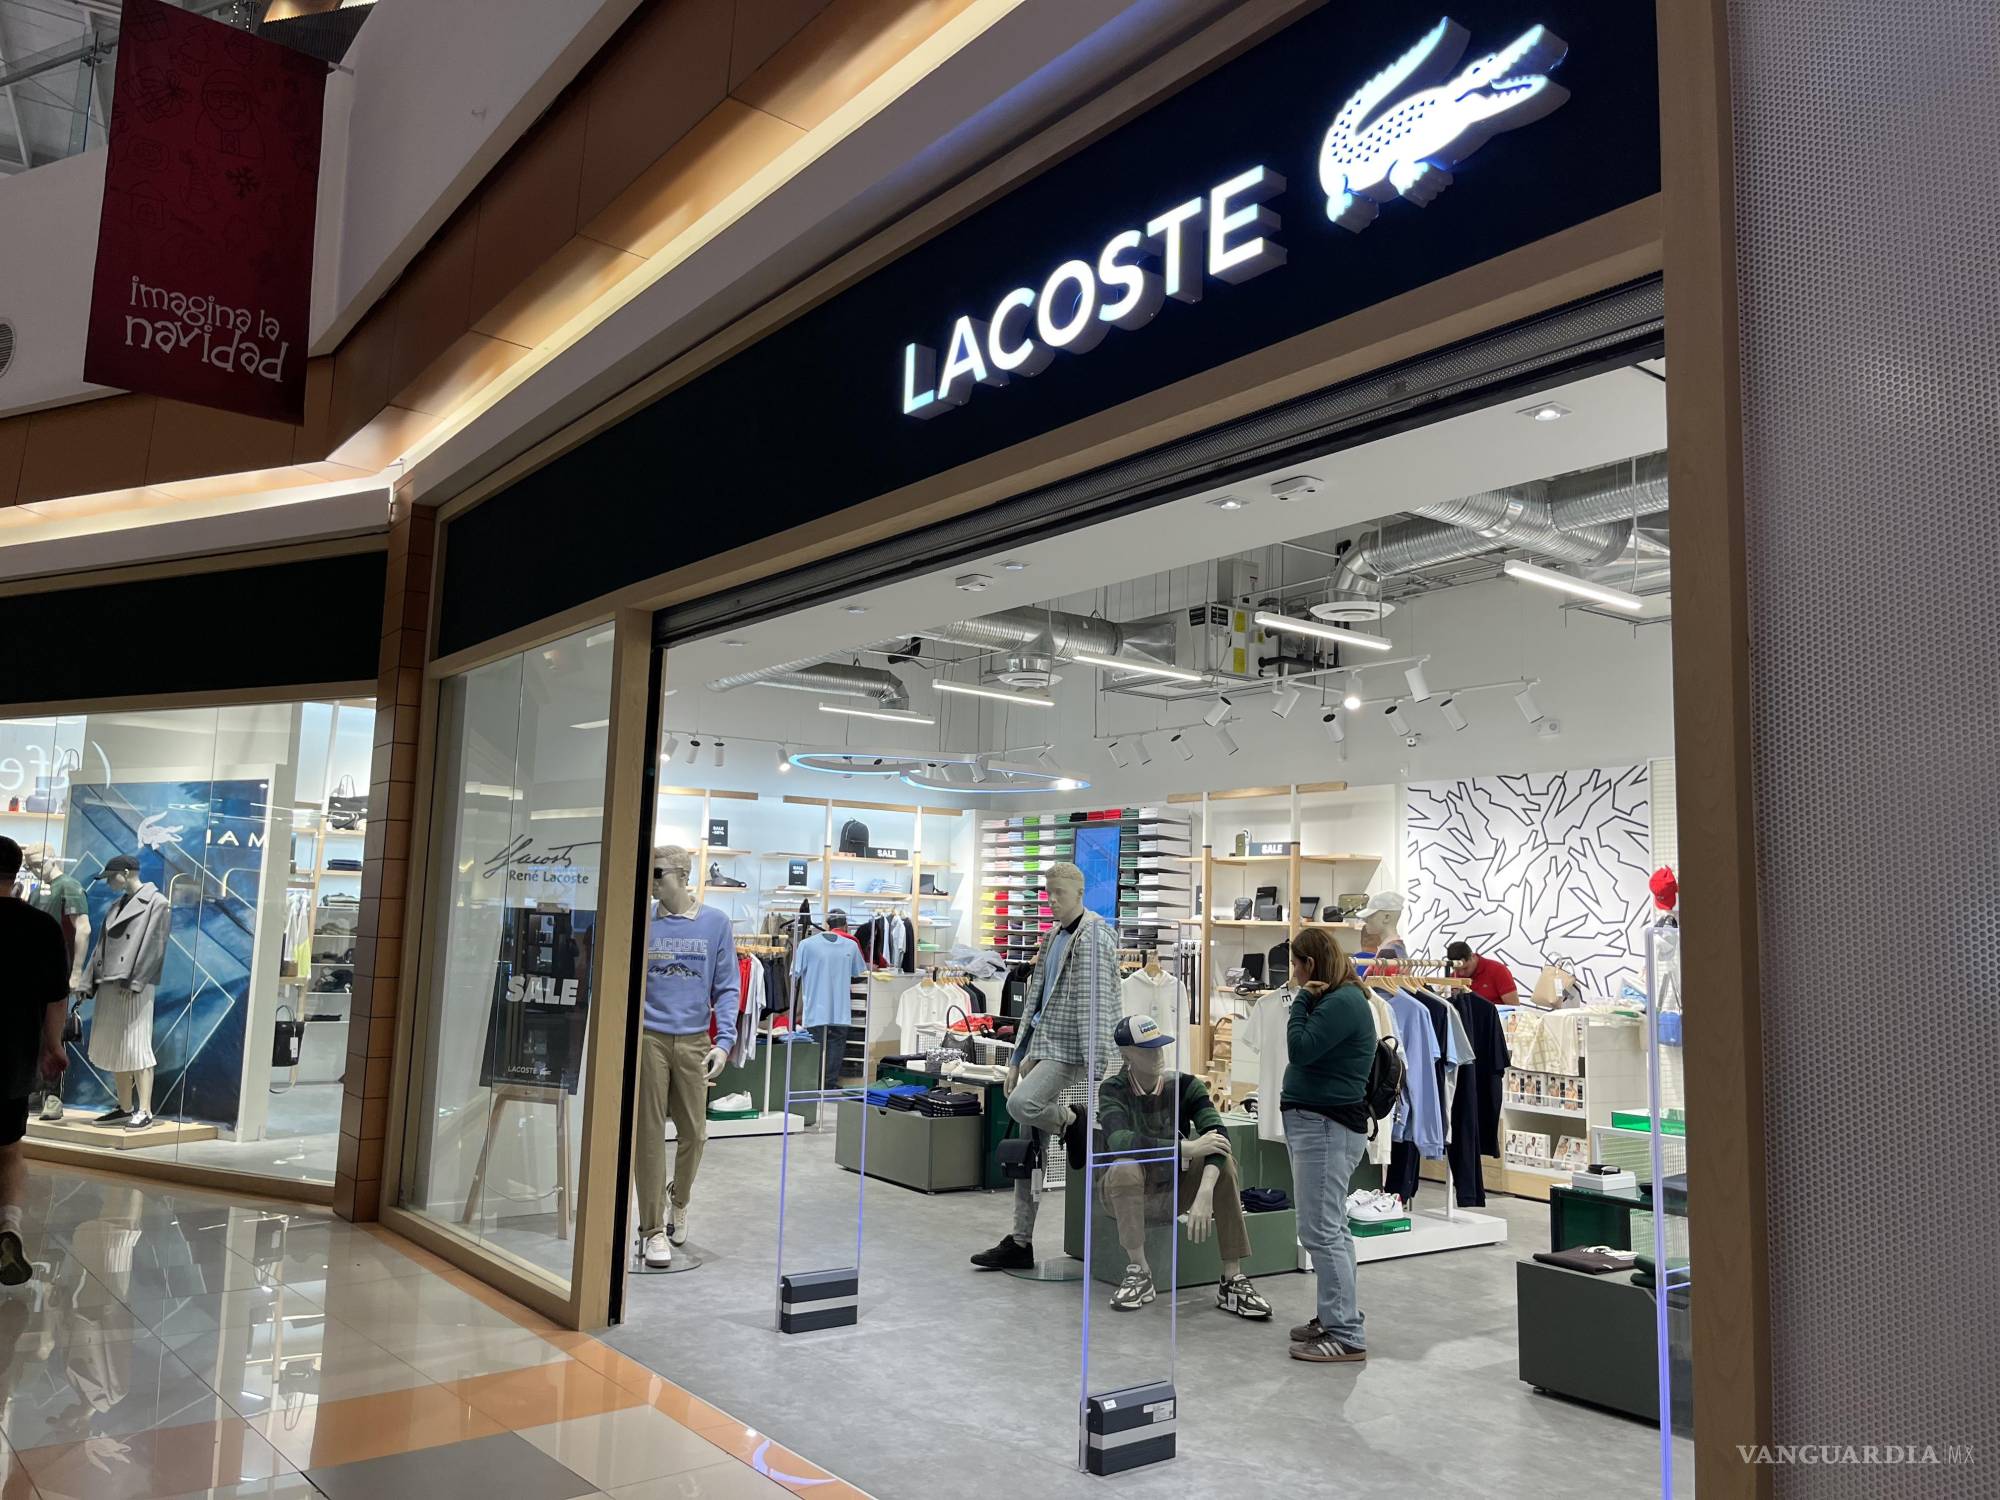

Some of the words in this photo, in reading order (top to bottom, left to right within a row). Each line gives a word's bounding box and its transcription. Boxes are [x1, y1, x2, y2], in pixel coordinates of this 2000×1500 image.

[903, 164, 1267, 415] LACOSTE
[129, 275, 252, 333] imagina
[258, 309, 280, 342] la
[125, 315, 289, 383] navidad
[877, 849, 897, 858] SALE
[1261, 844, 1283, 854] SALE
[508, 869, 539, 882] René
[543, 871, 590, 884] Lacoste
[505, 975, 579, 1006] SALE
[507, 1065, 537, 1075] LACOSTE
